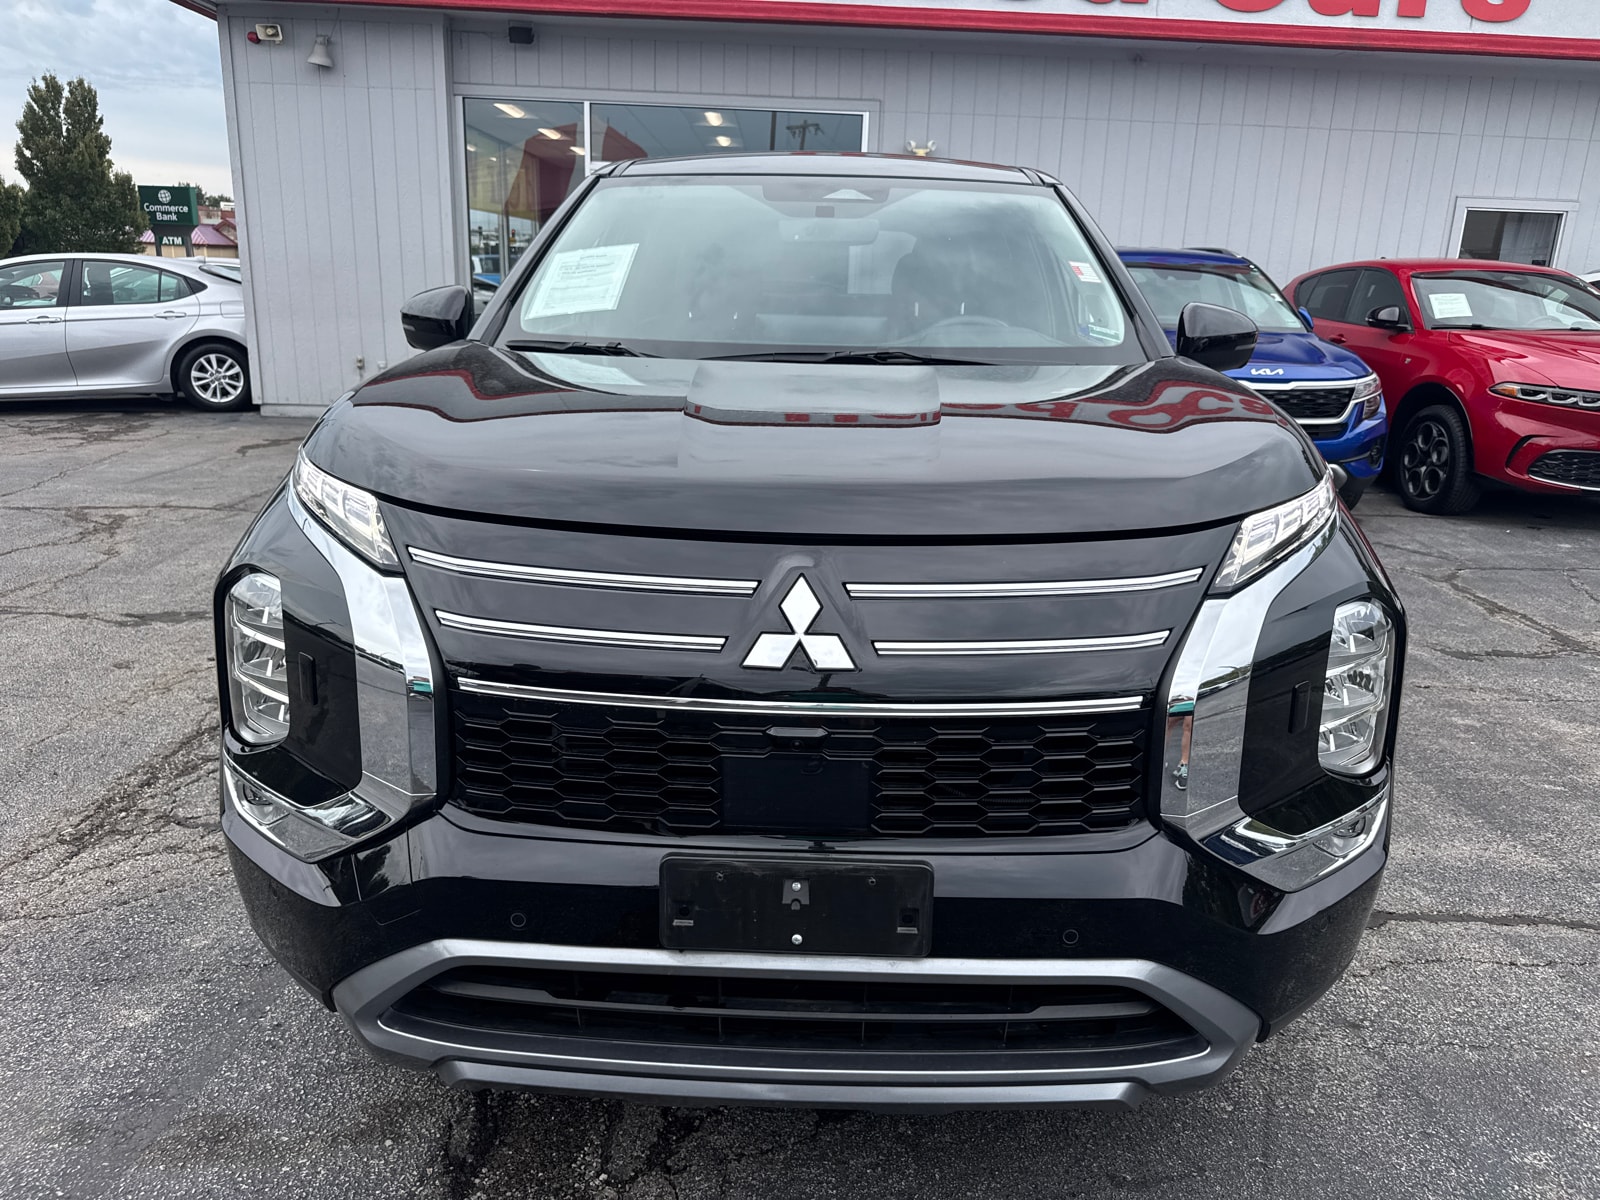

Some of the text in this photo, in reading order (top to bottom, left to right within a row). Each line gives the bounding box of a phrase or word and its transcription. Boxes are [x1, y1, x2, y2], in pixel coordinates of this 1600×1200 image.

[144, 203, 188, 212] Commerce
[156, 212, 178, 221] Bank
[162, 236, 182, 245] ATM
